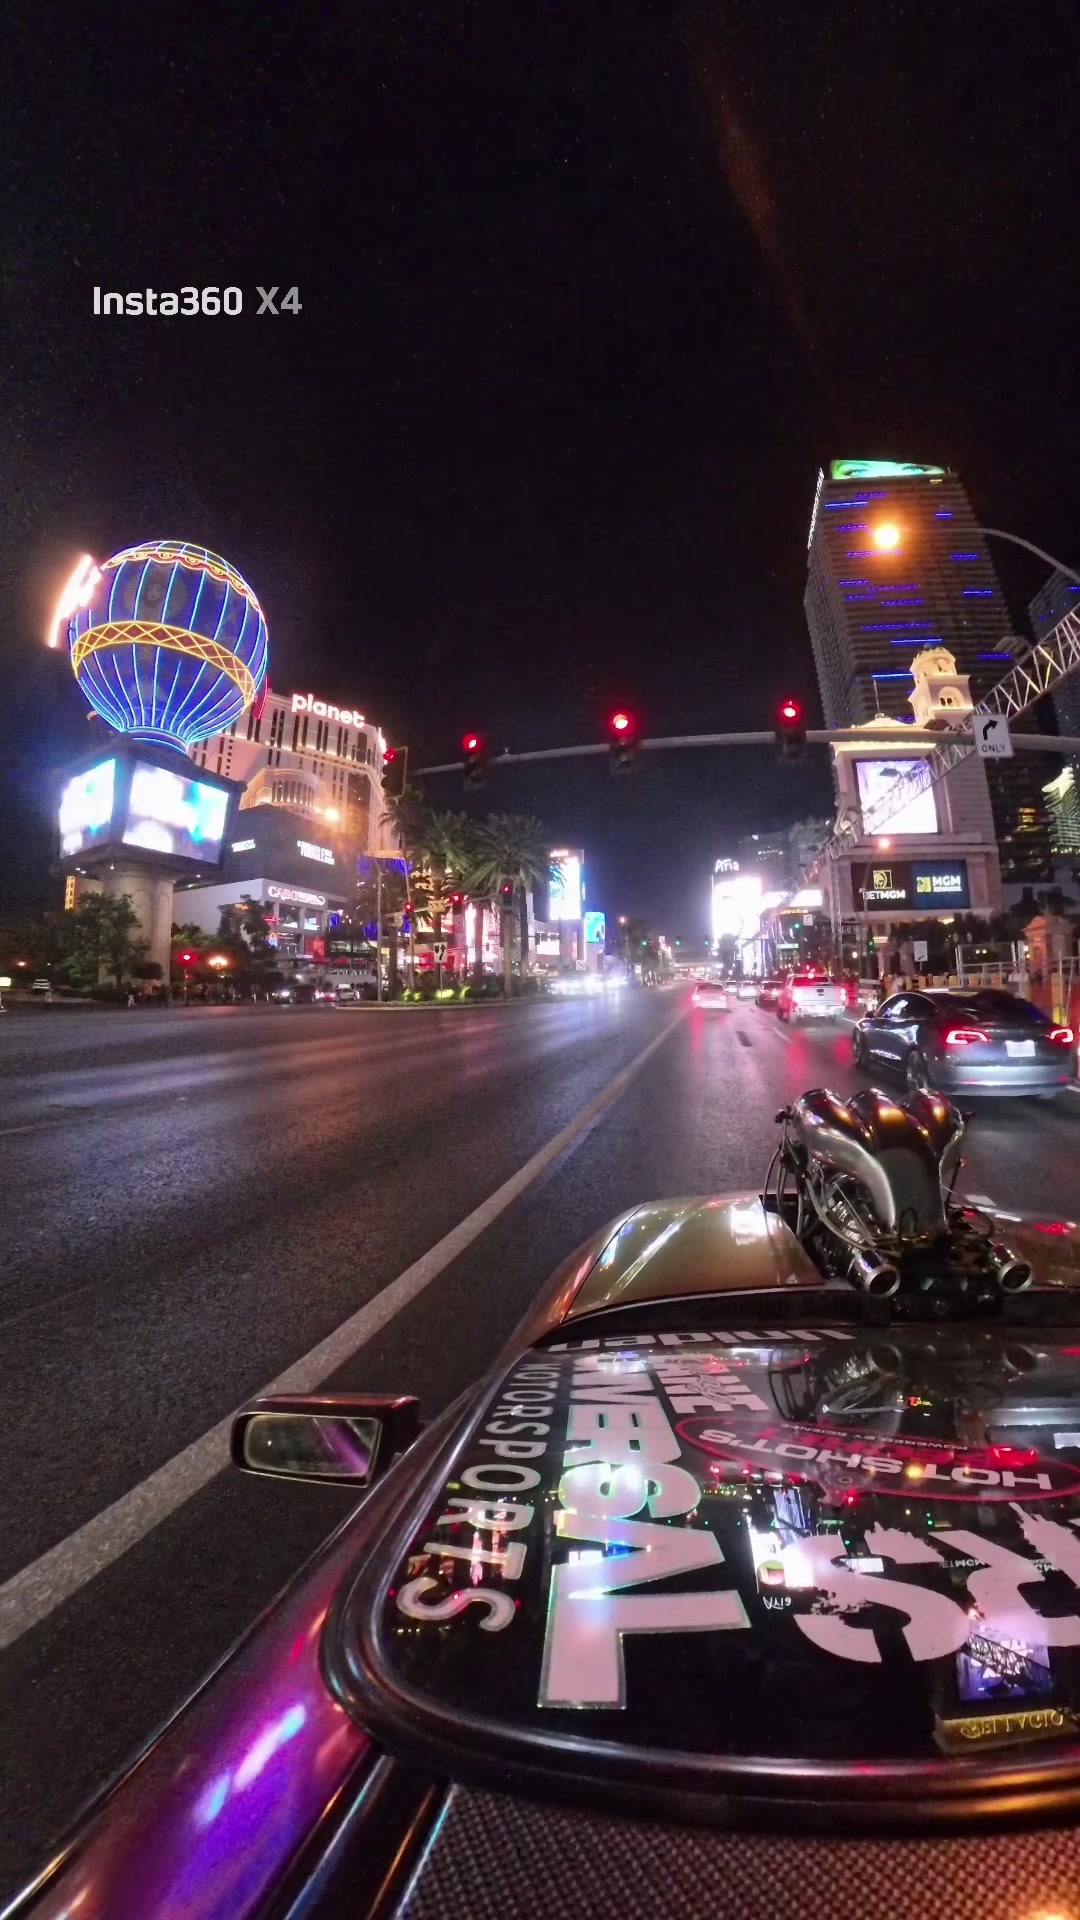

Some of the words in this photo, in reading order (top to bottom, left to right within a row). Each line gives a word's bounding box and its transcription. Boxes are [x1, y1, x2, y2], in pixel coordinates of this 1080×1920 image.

[291, 693, 366, 728] planet
[981, 743, 1007, 754] ONLY
[714, 858, 740, 873] Aria
[932, 875, 961, 887] MGM
[698, 1428, 903, 1474] SHOT'S
[918, 1463, 1052, 1490] HOT
[395, 1361, 564, 1632] MOTORSPORTS
[537, 1353, 752, 1710] UNIVERSAL
